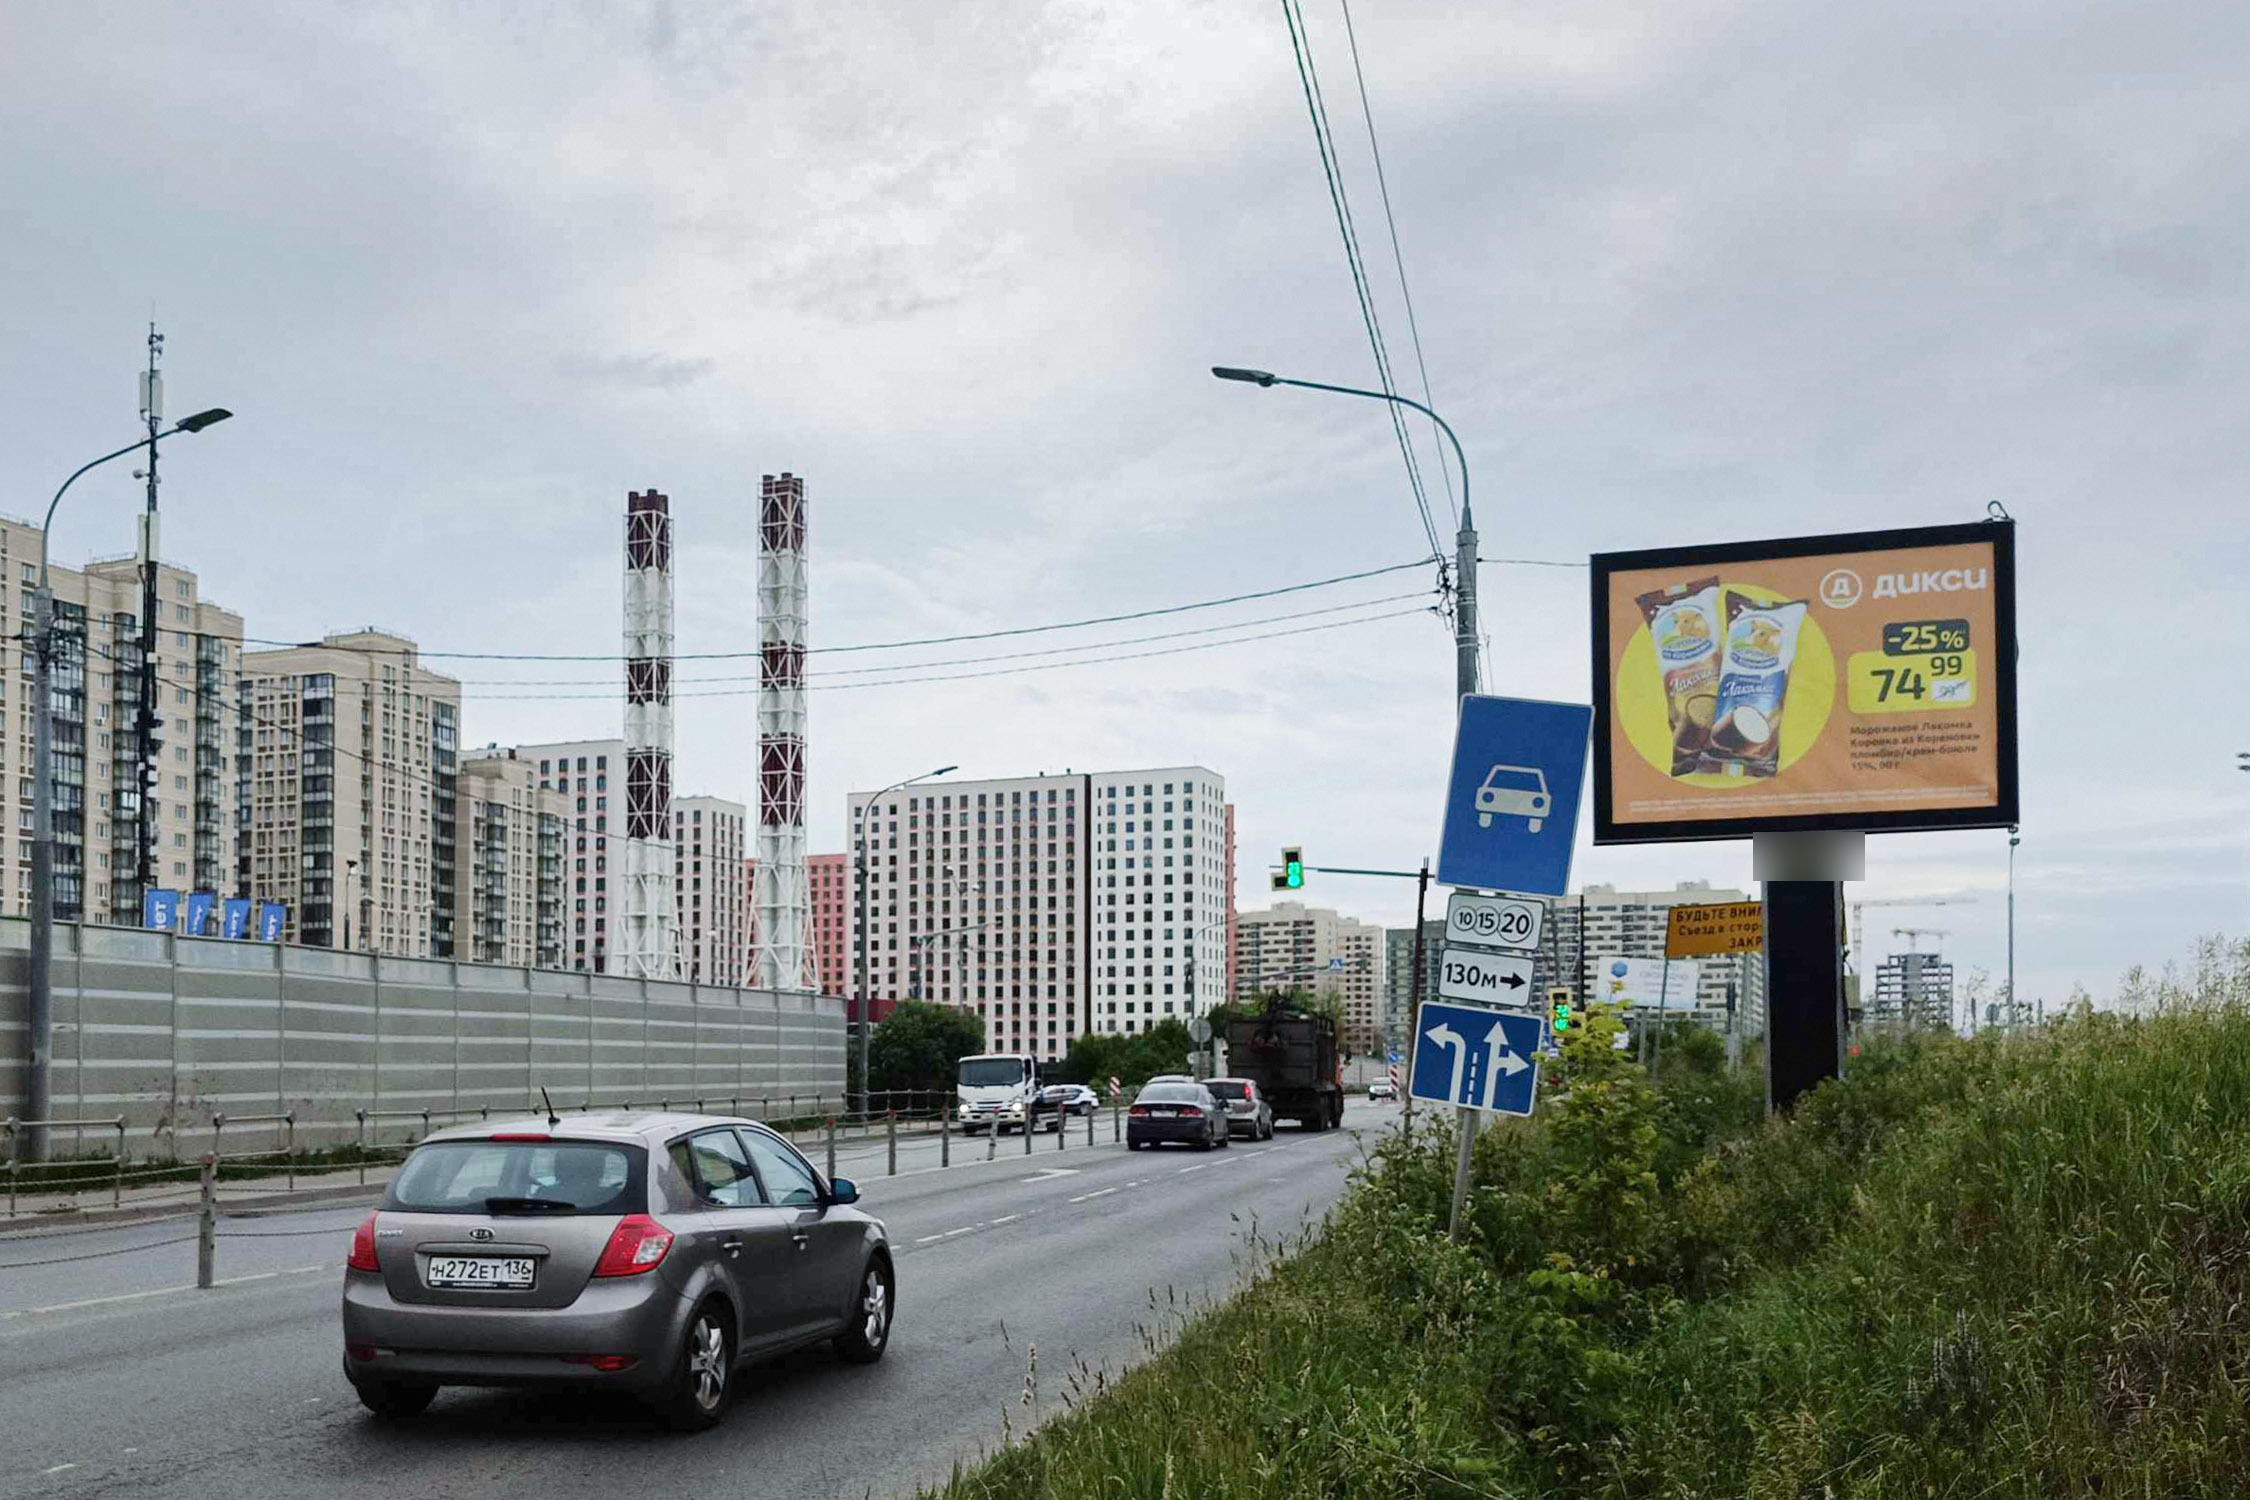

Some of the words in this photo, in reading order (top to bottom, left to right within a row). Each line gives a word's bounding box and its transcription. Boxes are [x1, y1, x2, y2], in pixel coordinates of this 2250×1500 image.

[1870, 668, 1926, 702] 74
[1930, 655, 1962, 676] 99
[1459, 912, 1473, 926] 10
[1478, 912, 1495, 930] 15
[1501, 912, 1530, 935] 20
[1676, 908, 1726, 922] БУДЬТЕ
[1729, 922, 1762, 934] стор
